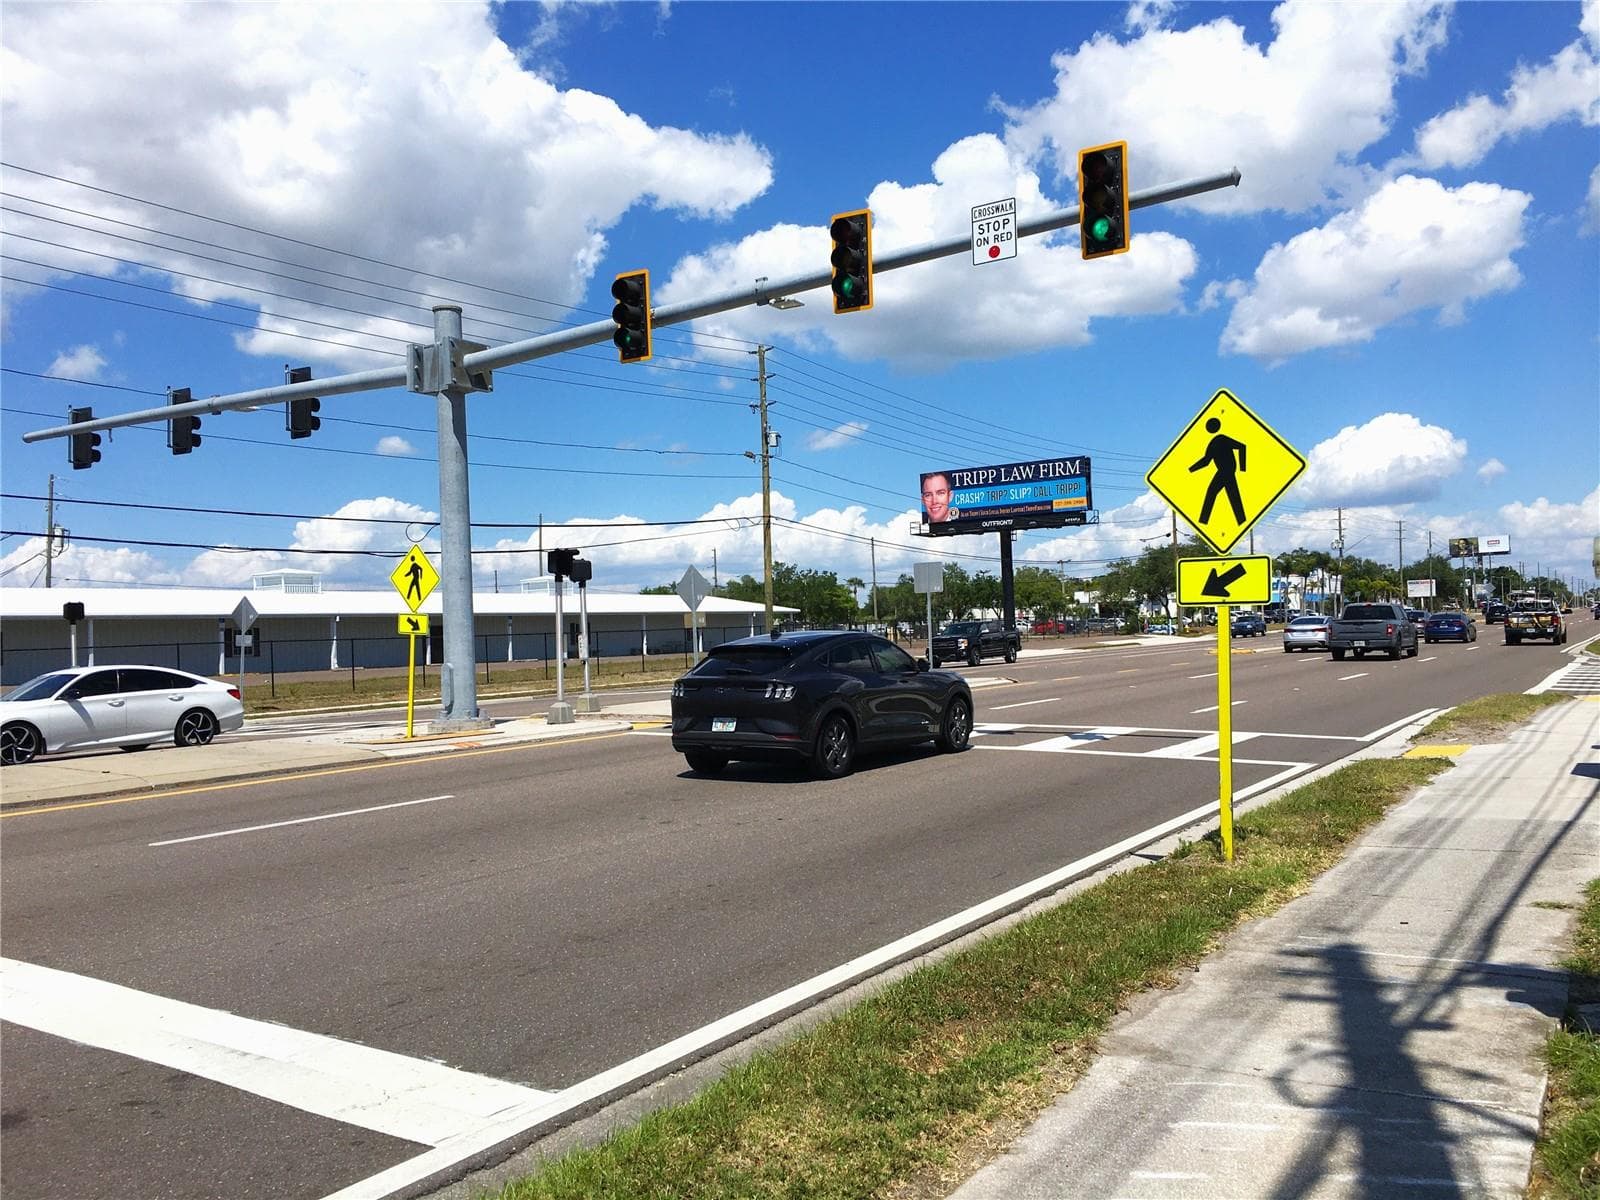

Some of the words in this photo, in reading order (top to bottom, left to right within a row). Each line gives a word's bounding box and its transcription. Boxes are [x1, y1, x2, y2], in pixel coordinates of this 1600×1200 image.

[974, 202, 1013, 219] CROSSWALK
[978, 218, 1010, 235] STOP
[976, 236, 989, 247] ON
[993, 231, 1013, 243] RED
[952, 469, 996, 487] TRIPP
[1000, 464, 1035, 482] LAW
[1039, 460, 1080, 478] FIRM
[954, 491, 985, 505] CRASH?
[986, 489, 1008, 502] TRIP?
[1009, 487, 1032, 500] SLIP?
[1033, 485, 1053, 497] CALL
